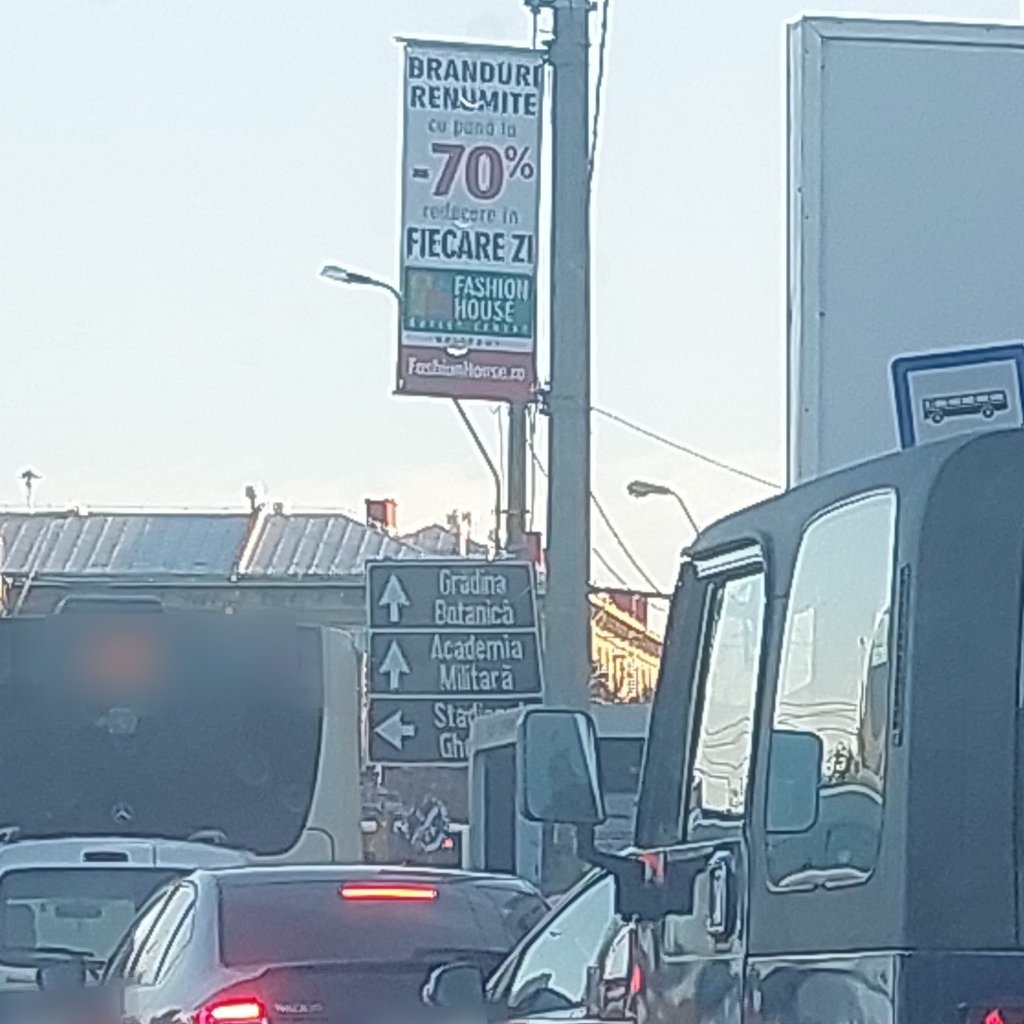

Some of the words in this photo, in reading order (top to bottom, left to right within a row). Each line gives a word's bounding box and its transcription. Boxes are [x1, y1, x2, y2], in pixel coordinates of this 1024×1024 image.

[408, 56, 540, 88] BRANDURI
[410, 85, 537, 116] RENUMITE
[427, 118, 447, 133] cu
[411, 142, 535, 201] -70%
[406, 226, 506, 263] FIECARE
[510, 233, 534, 264] ZI
[453, 275, 530, 302] FASHION
[453, 297, 516, 323] HOUSE
[430, 633, 524, 662] Academia
[439, 663, 514, 691] Militară
